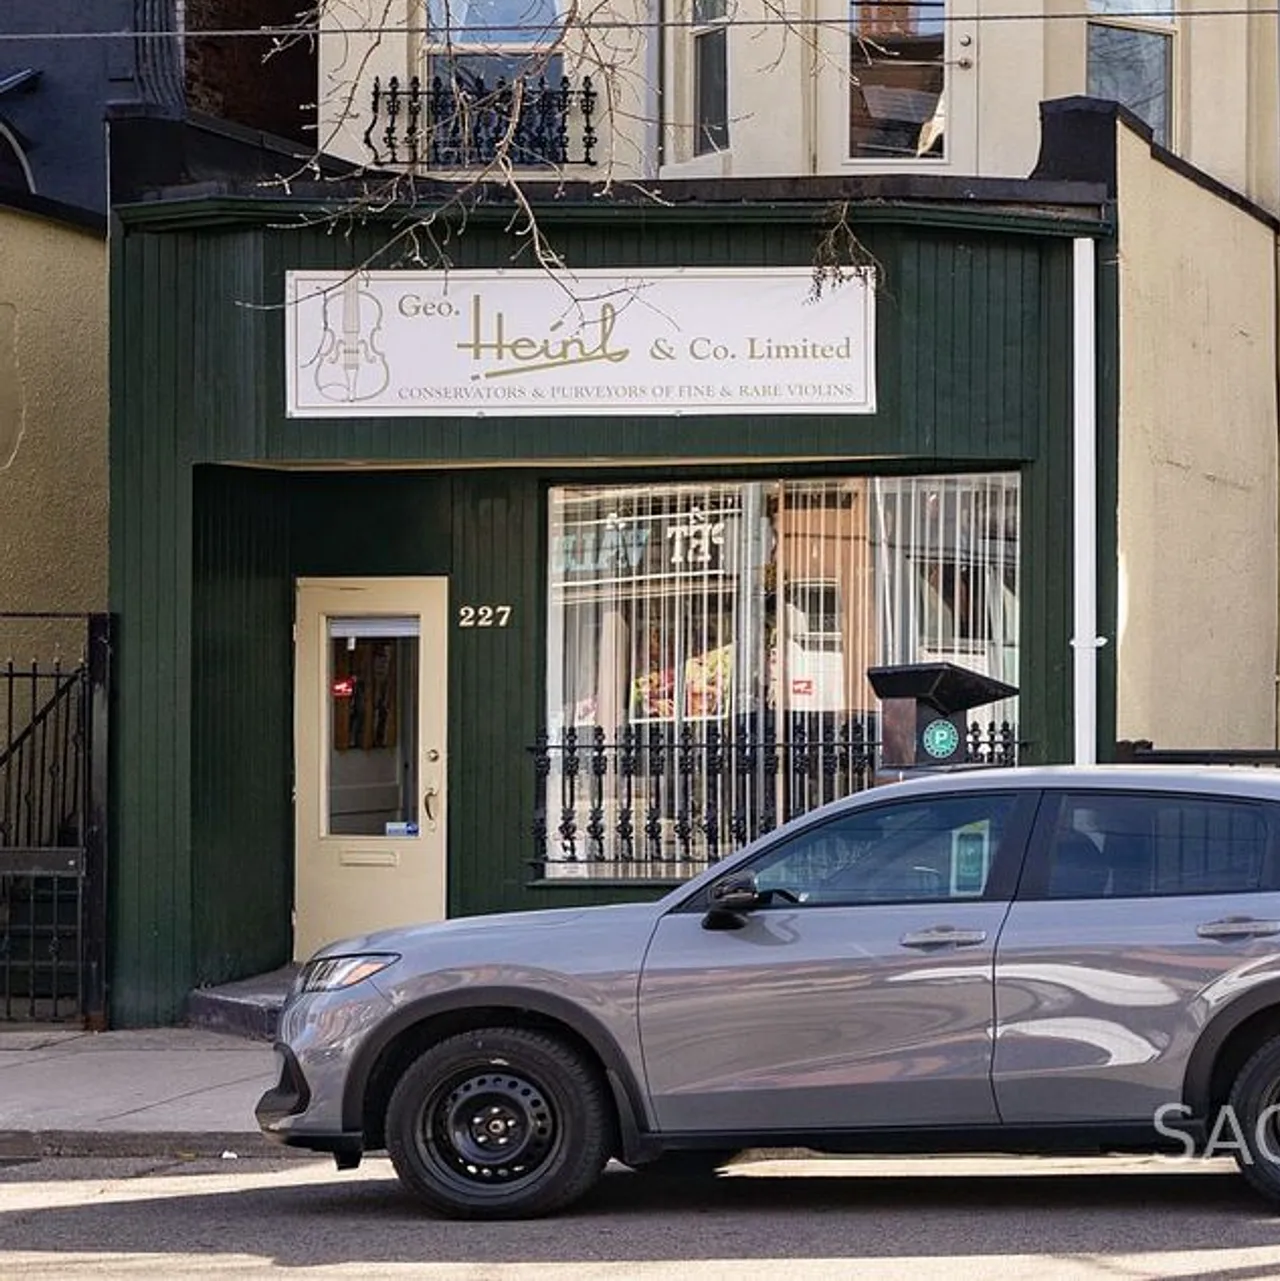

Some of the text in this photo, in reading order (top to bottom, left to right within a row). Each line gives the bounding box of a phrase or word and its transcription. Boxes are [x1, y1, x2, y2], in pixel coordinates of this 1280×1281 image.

[398, 294, 851, 362] Geo. Heinl & Co. Limited
[398, 383, 853, 400] CONSERVATORS & PURVEYORS OF FINE & RARE VIOLINS
[459, 605, 512, 627] 227
